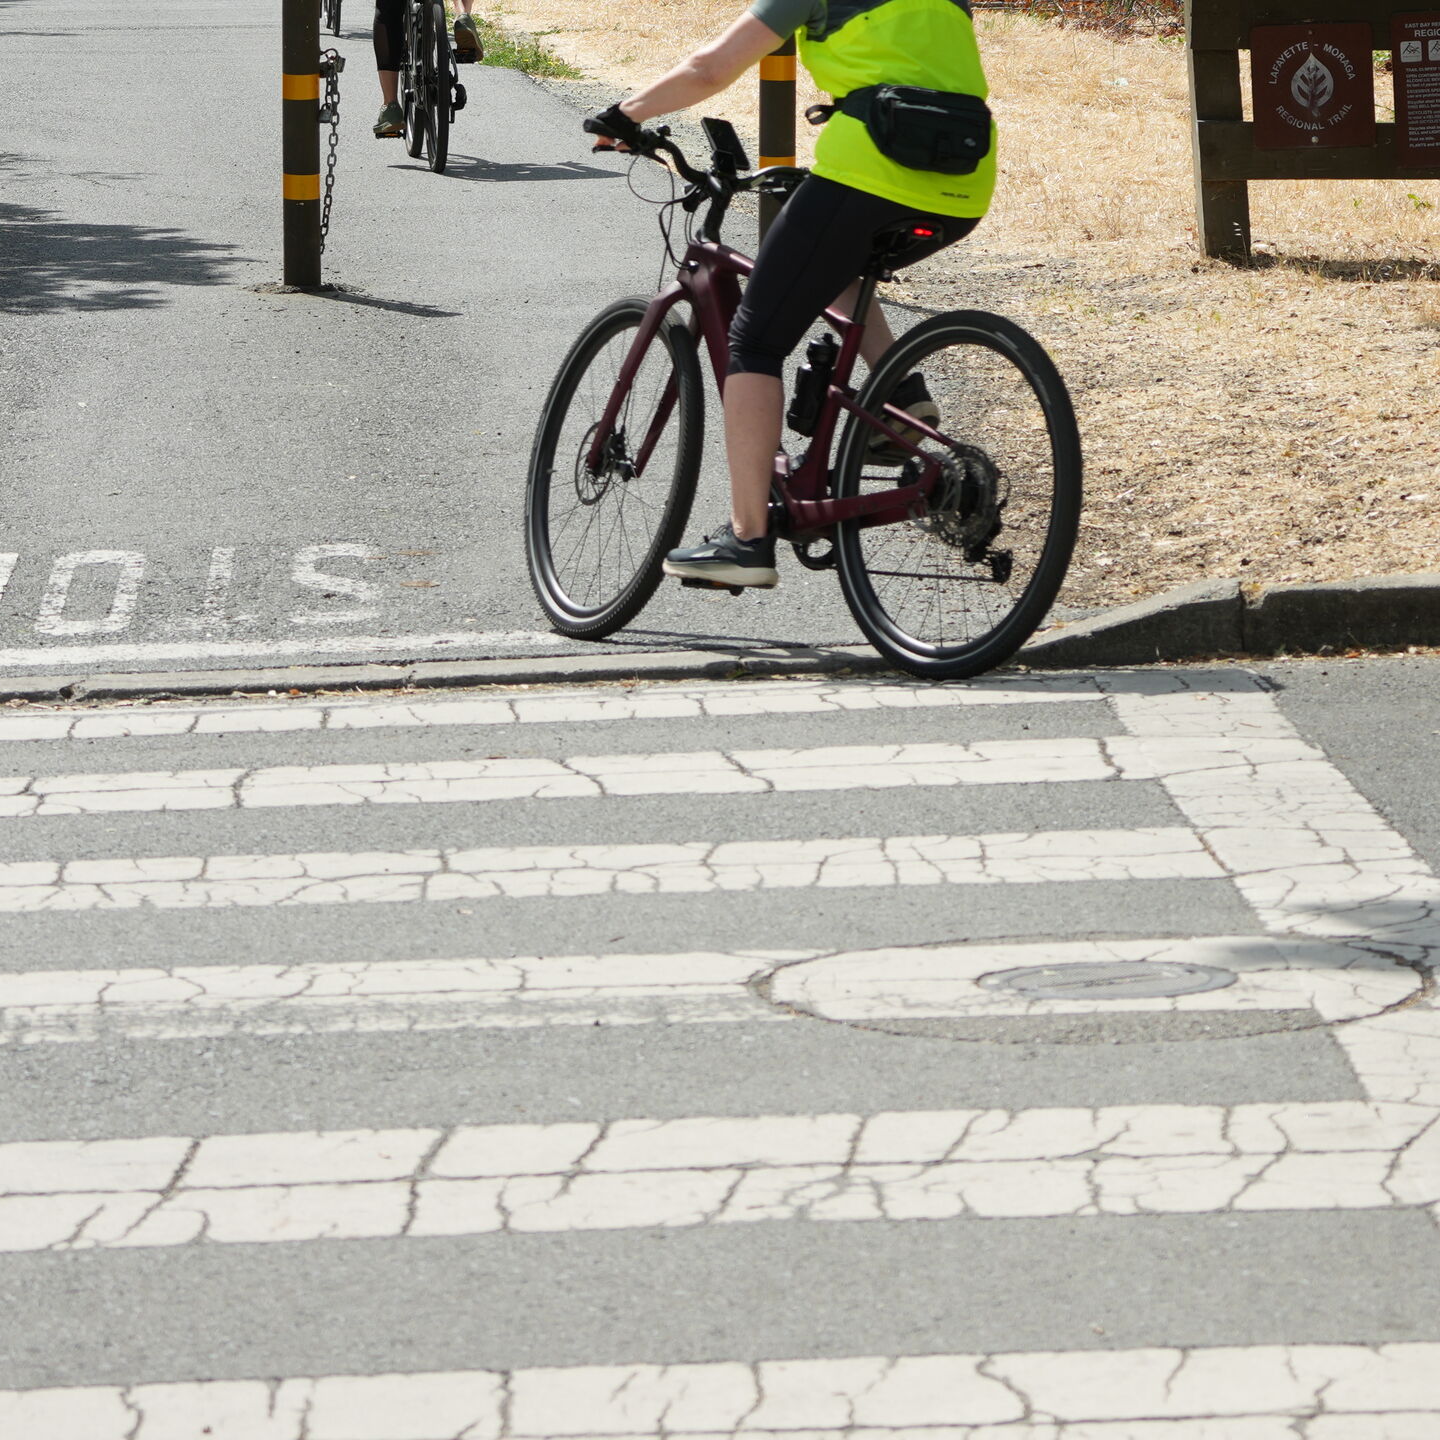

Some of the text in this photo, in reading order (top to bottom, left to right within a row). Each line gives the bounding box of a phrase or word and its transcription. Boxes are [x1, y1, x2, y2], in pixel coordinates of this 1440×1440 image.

[1269, 41, 1309, 85] LAFAYETTE
[1323, 43, 1357, 80] MORAGA
[1275, 103, 1353, 131] REGIONAL TRAIL
